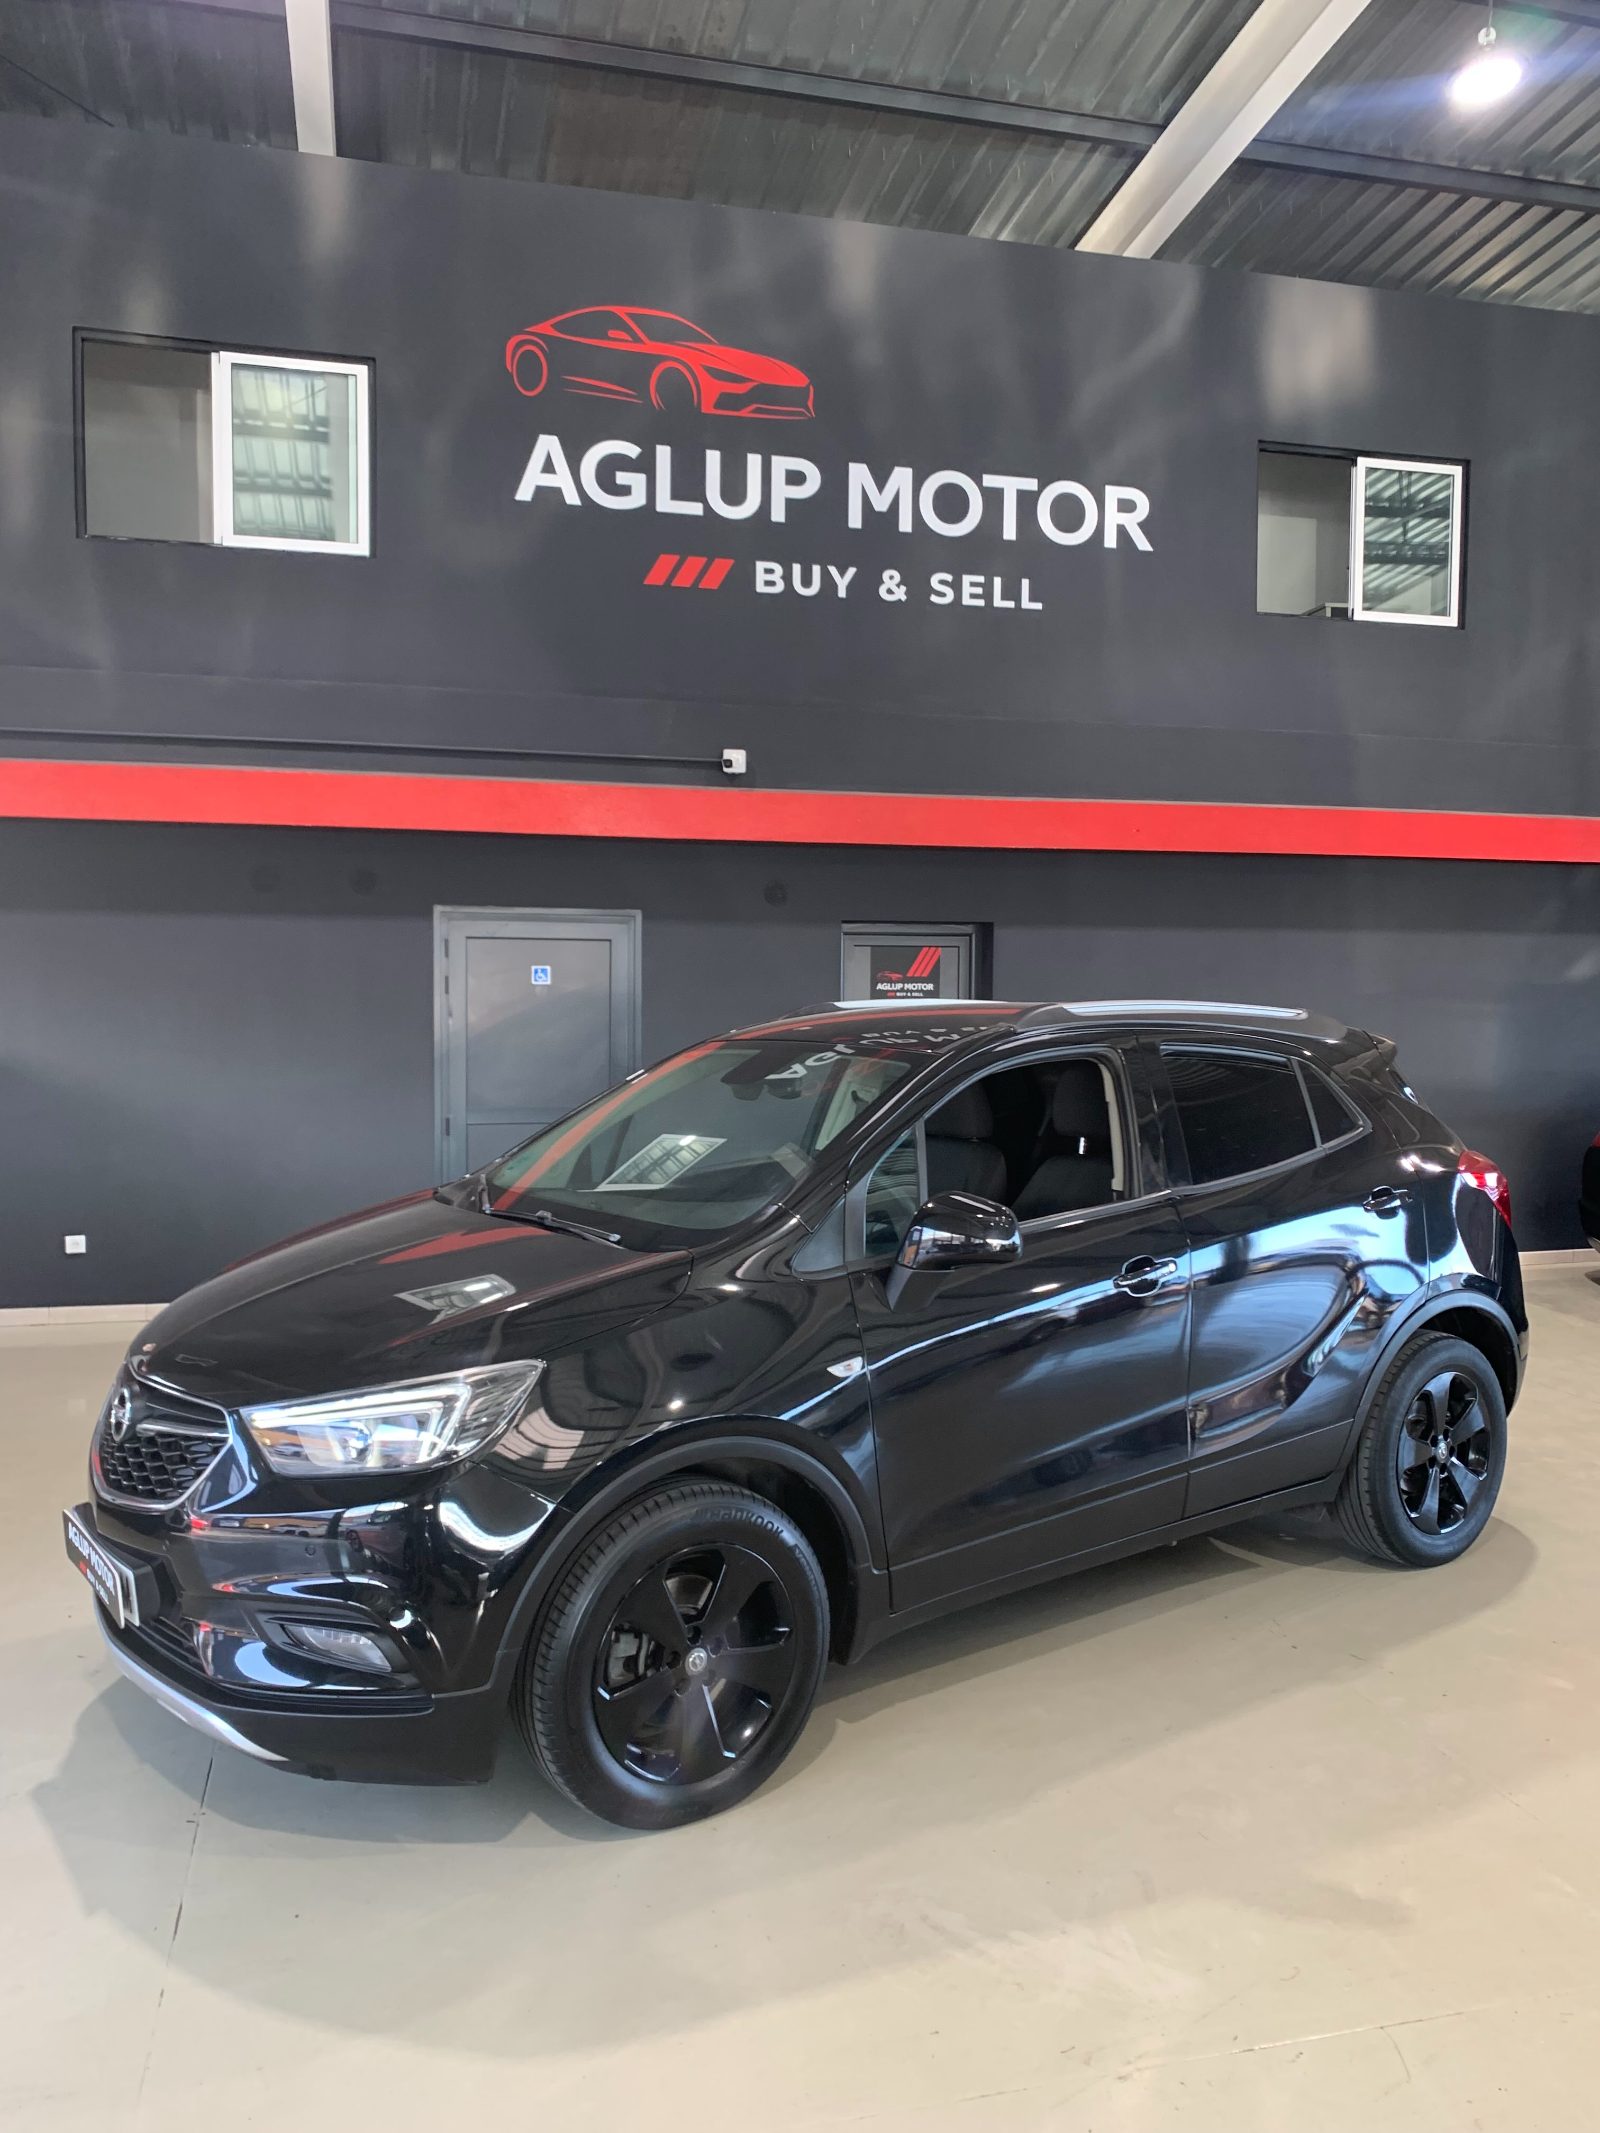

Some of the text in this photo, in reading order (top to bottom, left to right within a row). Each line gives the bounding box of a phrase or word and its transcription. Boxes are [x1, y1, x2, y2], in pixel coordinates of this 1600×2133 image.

[514, 433, 1154, 552] AGLUP MOTOR
[755, 560, 1043, 611] BUY & SELL
[876, 982, 934, 991] AGLUP MOTOR
